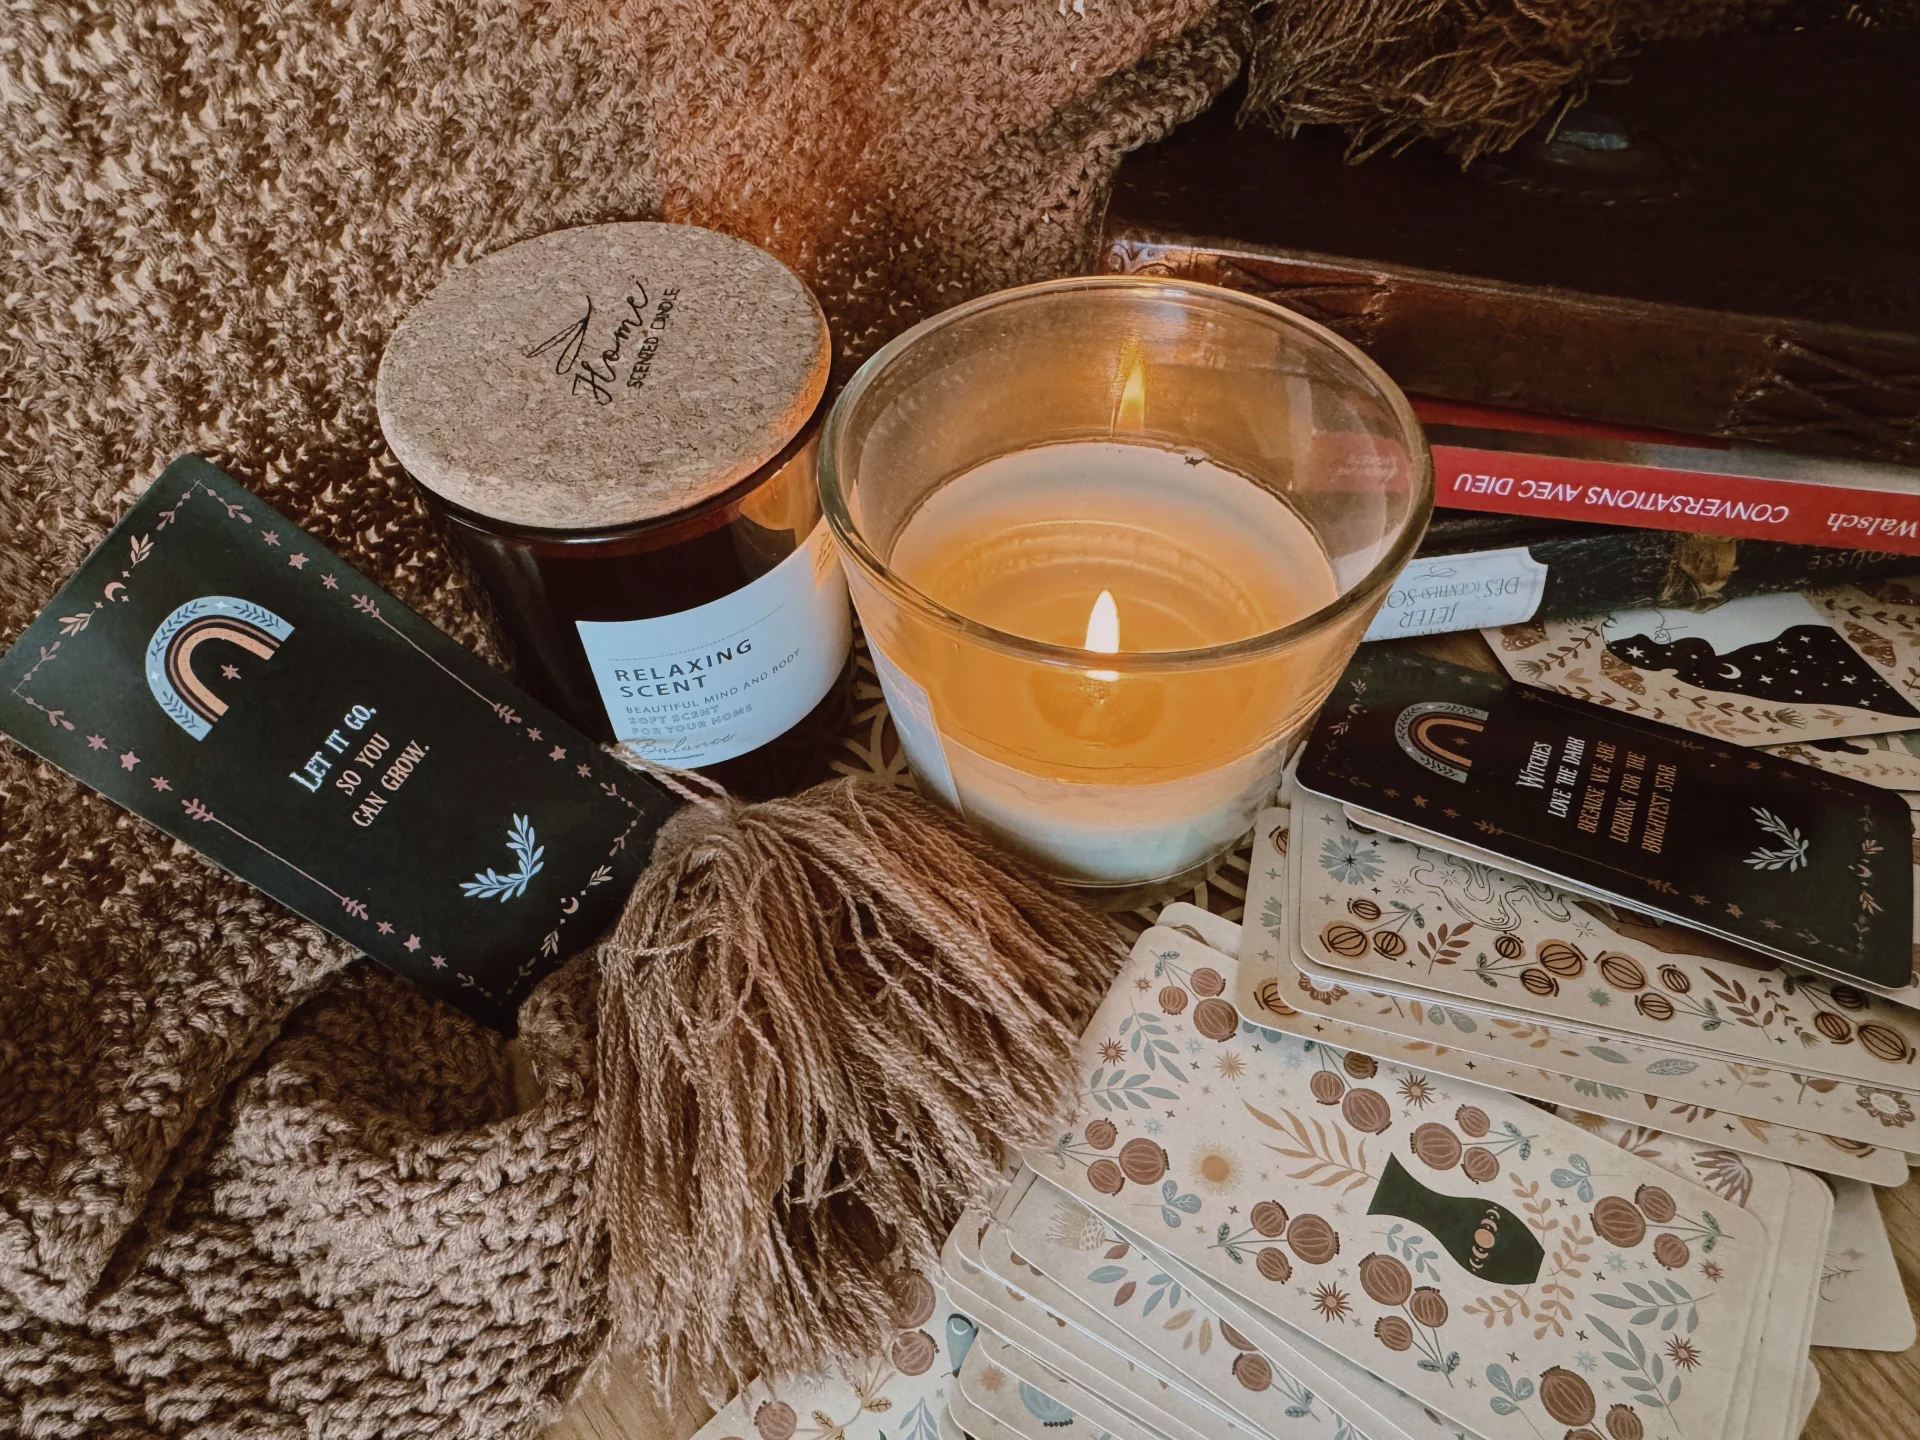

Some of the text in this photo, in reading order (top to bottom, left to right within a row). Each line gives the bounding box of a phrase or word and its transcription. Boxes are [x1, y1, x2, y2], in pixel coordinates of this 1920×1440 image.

[572, 281, 648, 405] Home
[627, 336, 658, 389] SCENTED
[1453, 473, 1789, 524] CONVERSATIONS AVEC DIEU
[1827, 512, 1917, 538] Walsch
[1382, 588, 1417, 609] SO
[1484, 577, 1520, 598] DES
[1399, 601, 1459, 628] JETER
[614, 638, 752, 682] RELAXING
[626, 648, 800, 714] BEAUTIFUL MIND AND BODY
[619, 675, 707, 698] SCENT
[628, 705, 720, 725] SOFT SCENT
[632, 703, 753, 735] FOR YOUR HOME
[289, 705, 377, 793] LET IT GO.
[336, 732, 390, 796] SO YOU
[637, 732, 737, 756] Balance
[352, 739, 430, 827] CAN GROW.
[1547, 736, 1586, 818] LOVE THE DARK
[1577, 741, 1616, 834] BECAUSE WE ARE
[1609, 751, 1647, 843] LOOKING FOR THE
[1641, 792, 1671, 854] BRIGHTEST
